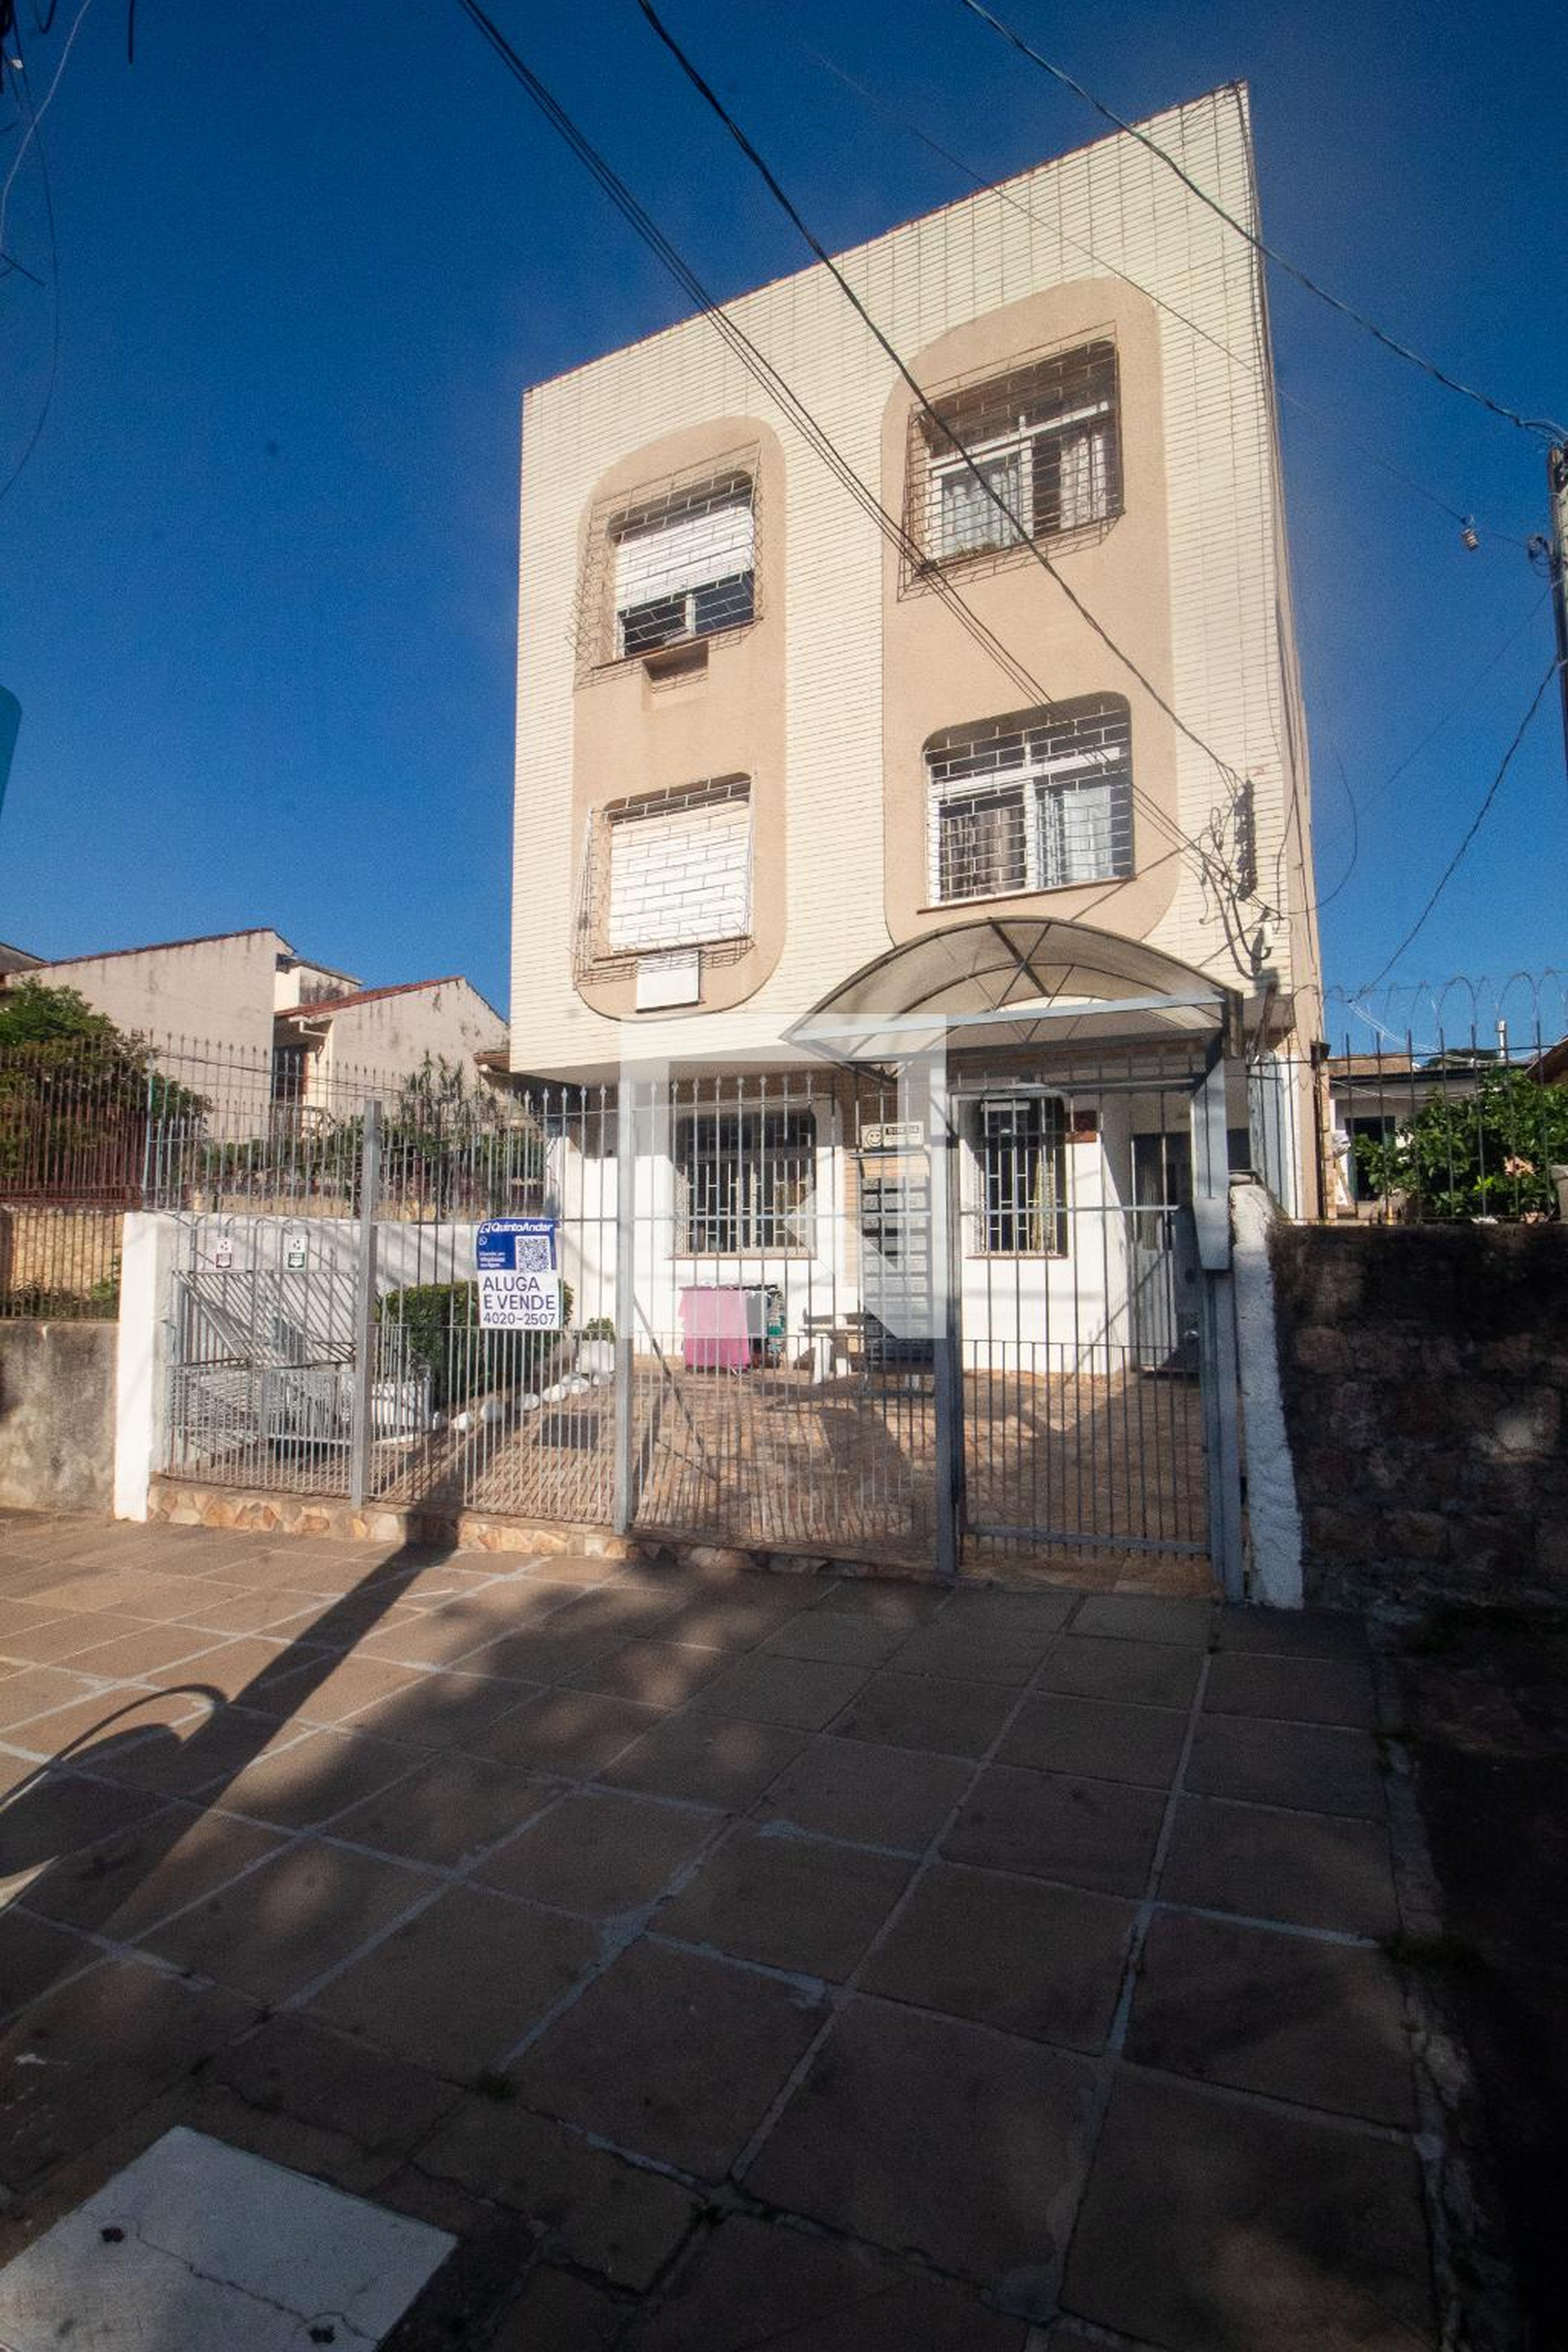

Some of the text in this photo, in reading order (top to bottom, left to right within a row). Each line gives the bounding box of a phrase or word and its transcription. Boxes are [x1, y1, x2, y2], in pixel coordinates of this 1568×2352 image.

[492, 1223, 553, 1232] QuintoAndar
[483, 1276, 540, 1292] ALUGA
[484, 1295, 556, 1310] E VENDE
[484, 1312, 555, 1325] 4020-2507
